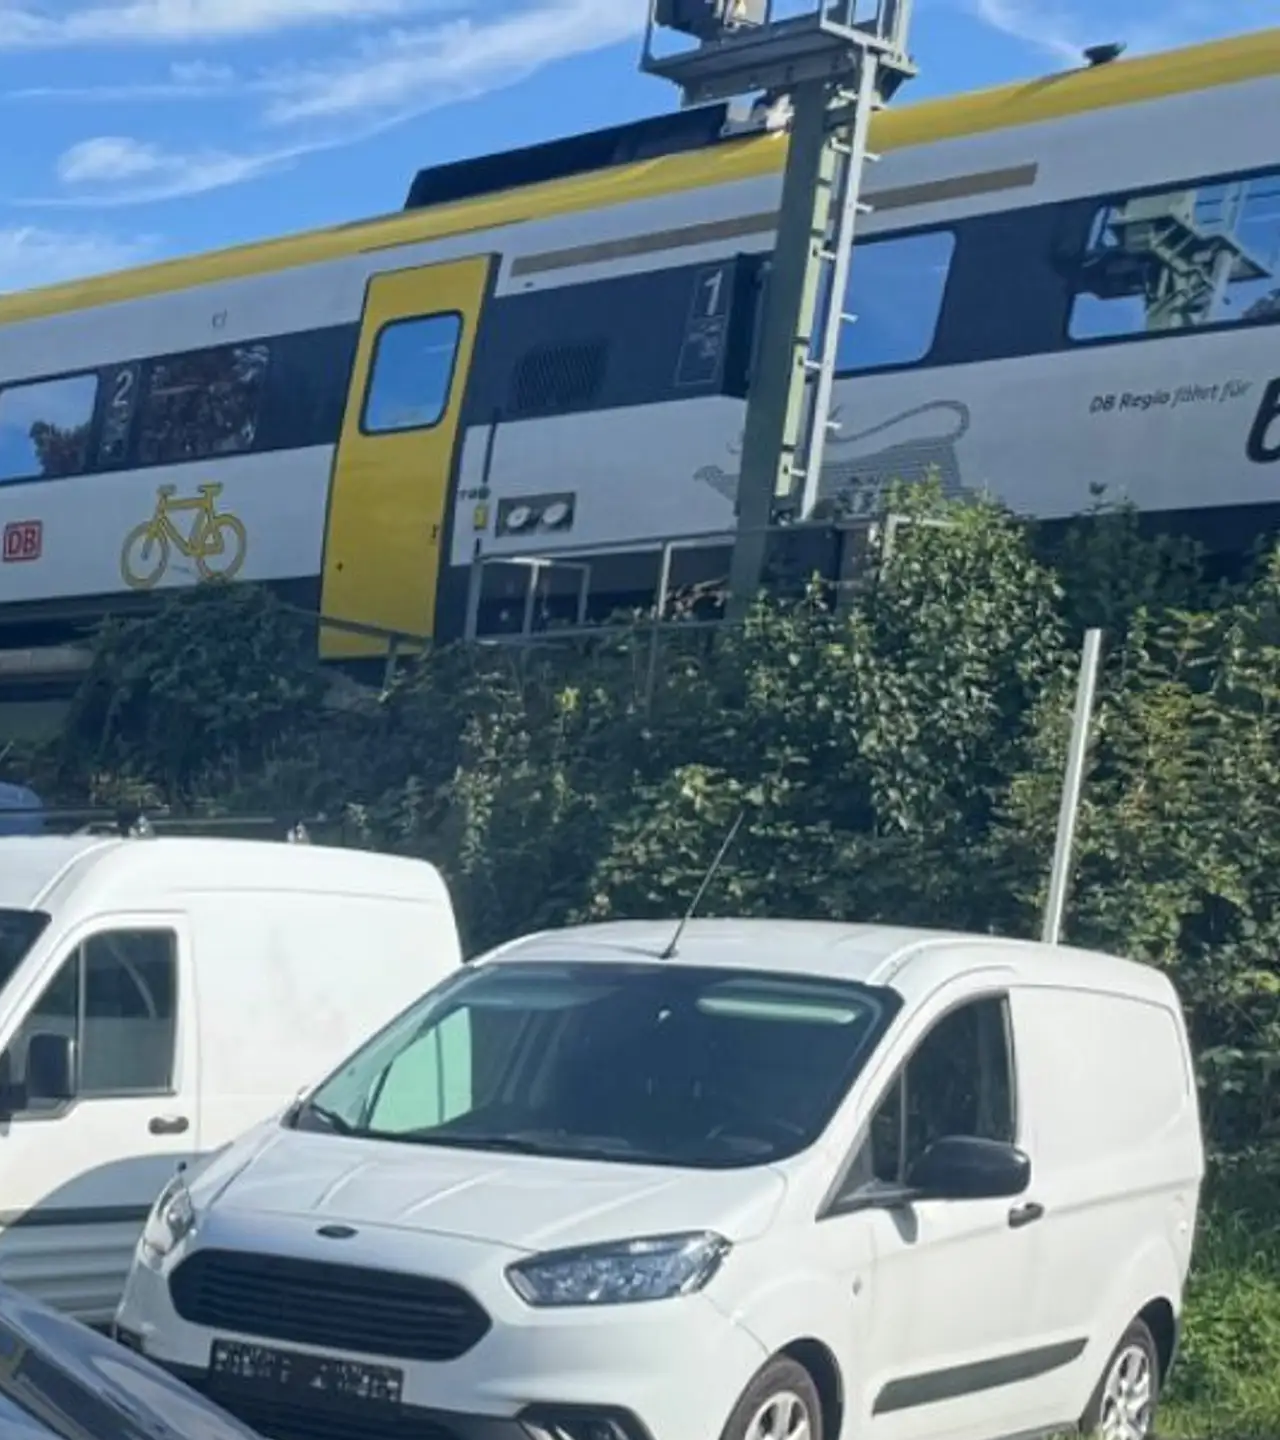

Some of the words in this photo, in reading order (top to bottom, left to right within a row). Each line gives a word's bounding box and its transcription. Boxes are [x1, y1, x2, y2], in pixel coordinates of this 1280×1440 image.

[704, 270, 723, 316] 1
[112, 370, 133, 408] 2
[6, 525, 39, 557] DB
